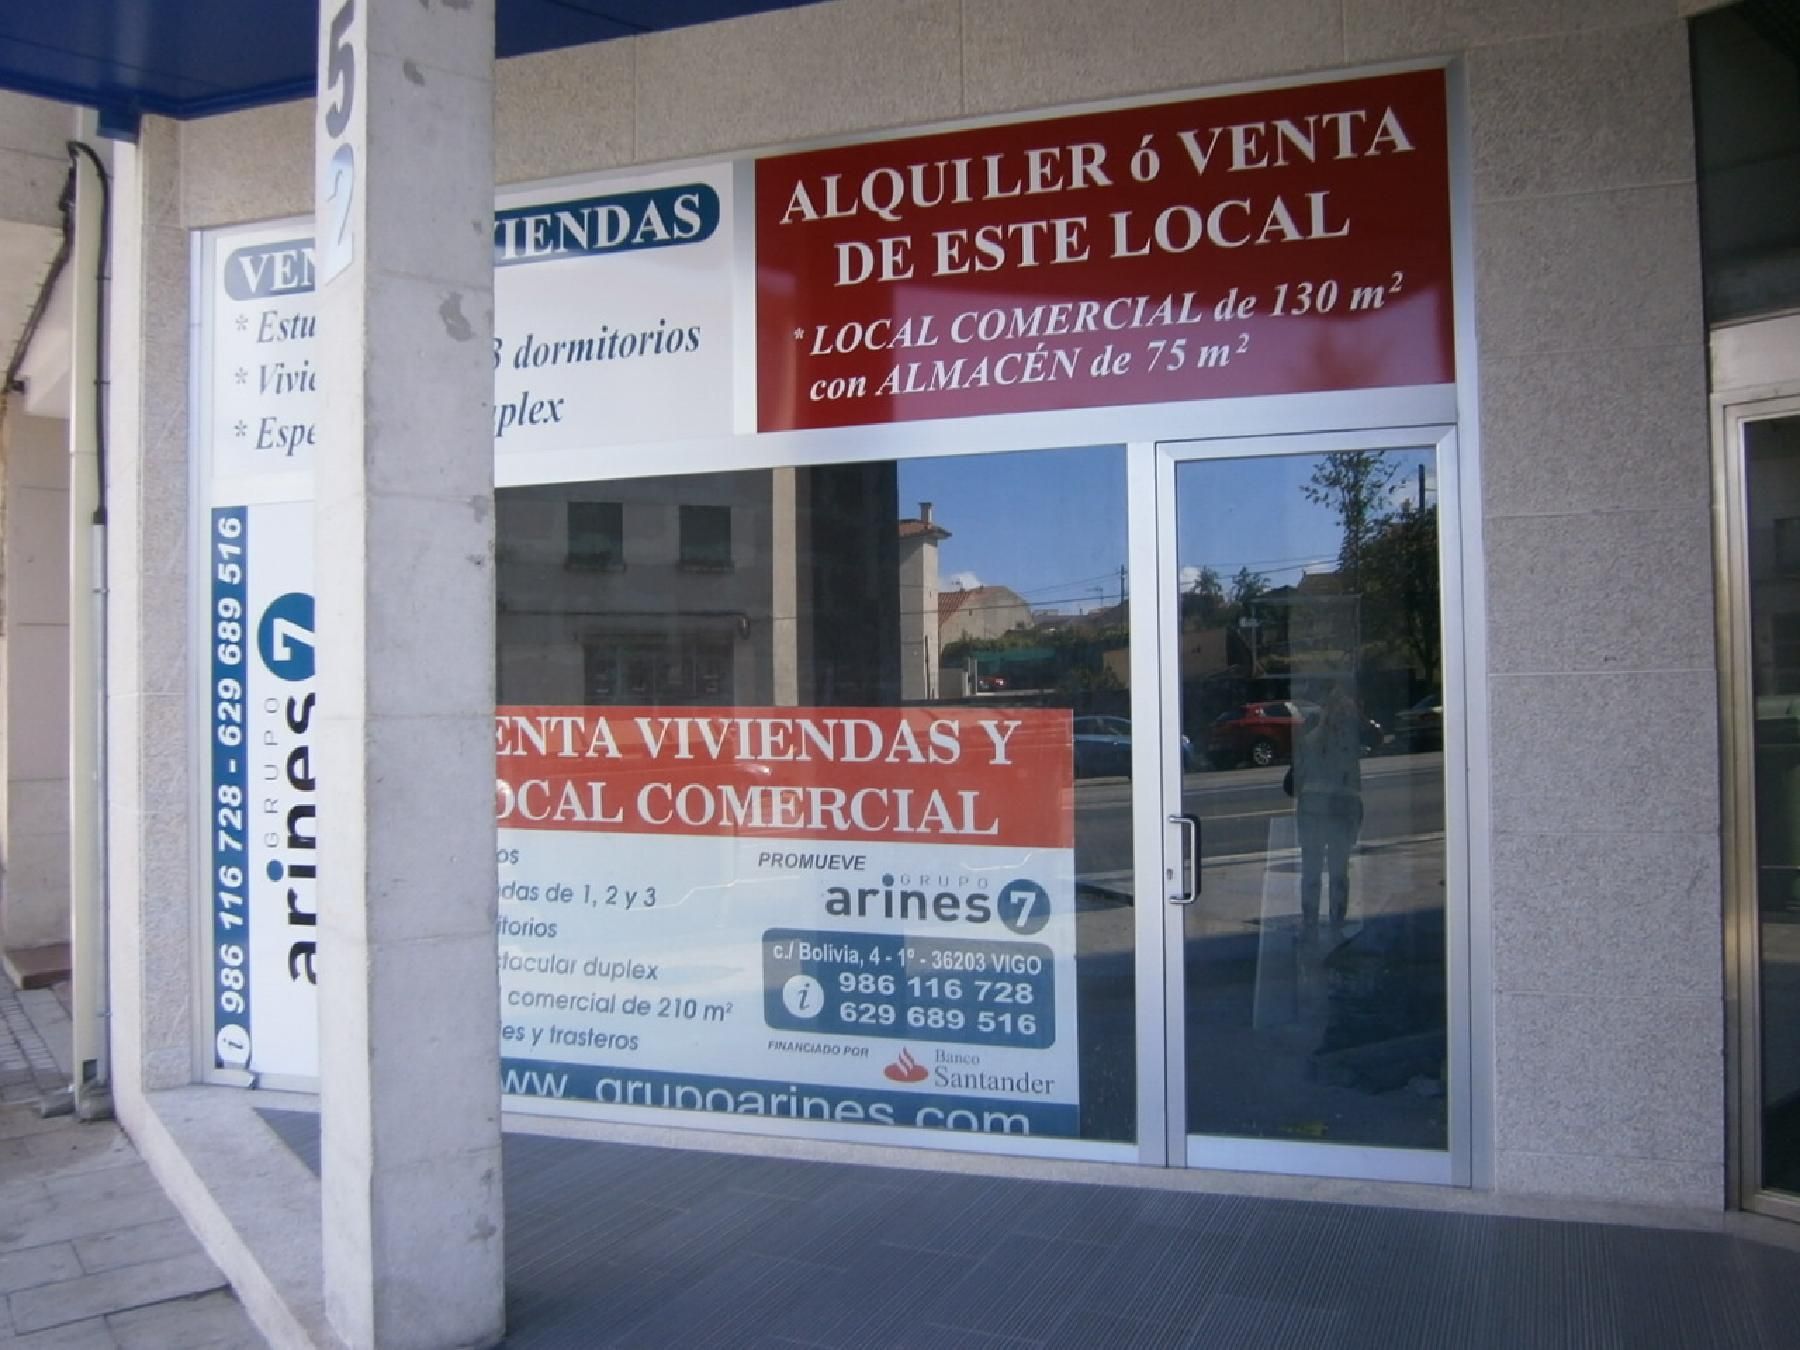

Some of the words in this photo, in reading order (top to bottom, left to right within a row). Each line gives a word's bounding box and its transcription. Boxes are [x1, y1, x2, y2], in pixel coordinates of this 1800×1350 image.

[779, 140, 1113, 224] ALQUILER
[1130, 134, 1160, 182] ó
[1177, 105, 1415, 176] VENTA
[494, 193, 701, 260] IENDAS
[834, 235, 914, 287] DE
[931, 216, 1090, 277] ESTE
[1110, 190, 1350, 259] LOCAL
[809, 314, 939, 356] LOCAL
[951, 291, 1202, 344] COMERCIAL
[1213, 287, 1257, 322] de
[1268, 279, 1338, 318] 130
[513, 318, 701, 370] dormitorios
[809, 376, 867, 402] con
[874, 342, 1083, 397] ALMACÉN
[1090, 345, 1131, 376] de
[1147, 338, 1187, 372] 75
[494, 391, 565, 438] plex
[217, 517, 242, 585] 516
[217, 597, 242, 665] 689
[217, 678, 242, 746] 629
[634, 717, 960, 764] VIVIENDAS
[977, 719, 1022, 765] Y
[263, 697, 280, 849] GRUPO
[218, 784, 243, 852] 728
[637, 782, 998, 835] COMERCIAL
[758, 851, 867, 870] PROMUEVE
[900, 874, 988, 890] GRUPO
[218, 864, 243, 930] 116
[497, 881, 540, 902] das
[546, 882, 573, 903] de
[604, 885, 618, 905] 2
[625, 889, 638, 910] y
[643, 886, 656, 907] 3
[825, 873, 992, 923] arines
[1009, 890, 1036, 928] 7
[220, 943, 245, 1014] 986
[497, 950, 577, 975] tacular
[583, 956, 659, 981] duplex
[868, 945, 880, 965] 4
[931, 950, 986, 973] 36203
[993, 955, 1042, 974] VIGO
[507, 989, 616, 1014] comercial
[622, 995, 651, 1016] de
[657, 996, 698, 1020] 210
[839, 971, 895, 995] 986
[907, 976, 963, 1000] 116
[974, 980, 1033, 1004] 728
[531, 1027, 544, 1047] y
[550, 1023, 639, 1051] trasteros
[840, 1003, 896, 1025] 629
[907, 1006, 965, 1030] 689
[976, 1012, 1036, 1035] 516
[767, 1040, 841, 1056] FINANCIADO
[843, 1046, 870, 1058] POR
[934, 1048, 981, 1066] Banco
[934, 1066, 1056, 1094] Santander
